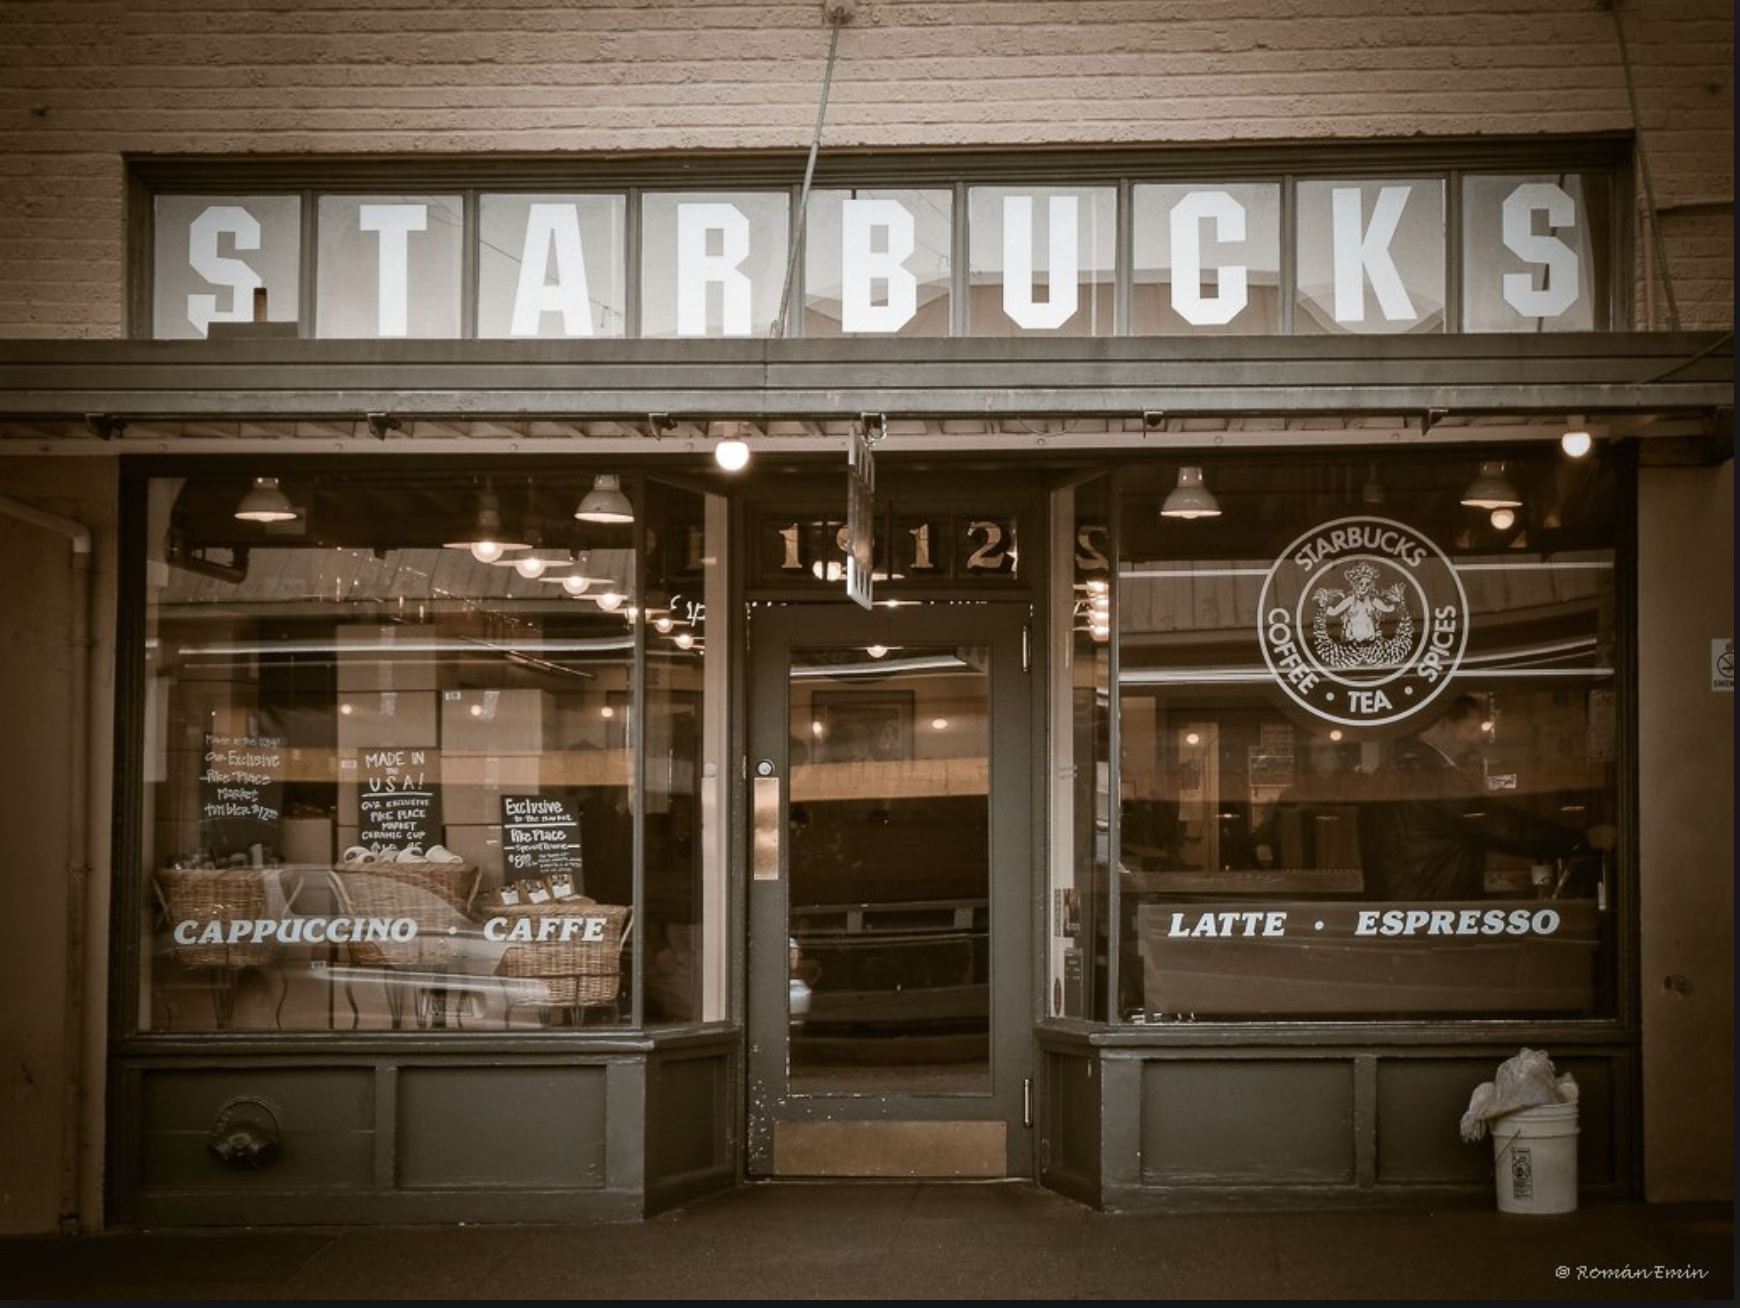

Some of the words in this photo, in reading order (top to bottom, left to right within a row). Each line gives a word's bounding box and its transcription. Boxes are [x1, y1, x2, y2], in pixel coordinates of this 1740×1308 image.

[186, 183, 1580, 337] STARBUCKS
[1294, 526, 1428, 572] STARBUCKS
[1267, 607, 1320, 696] COFFEE
[1417, 605, 1457, 683] SPICES
[1347, 689, 1393, 714] TEA
[364, 751, 406, 769] MADE
[411, 750, 425, 766] IN
[504, 797, 565, 817] Exclusive
[173, 917, 419, 945] CAPPUCCINO
[483, 917, 608, 942] CAFFE
[1167, 912, 1288, 938] LATTE
[1354, 909, 1561, 936] ESPRESSO
